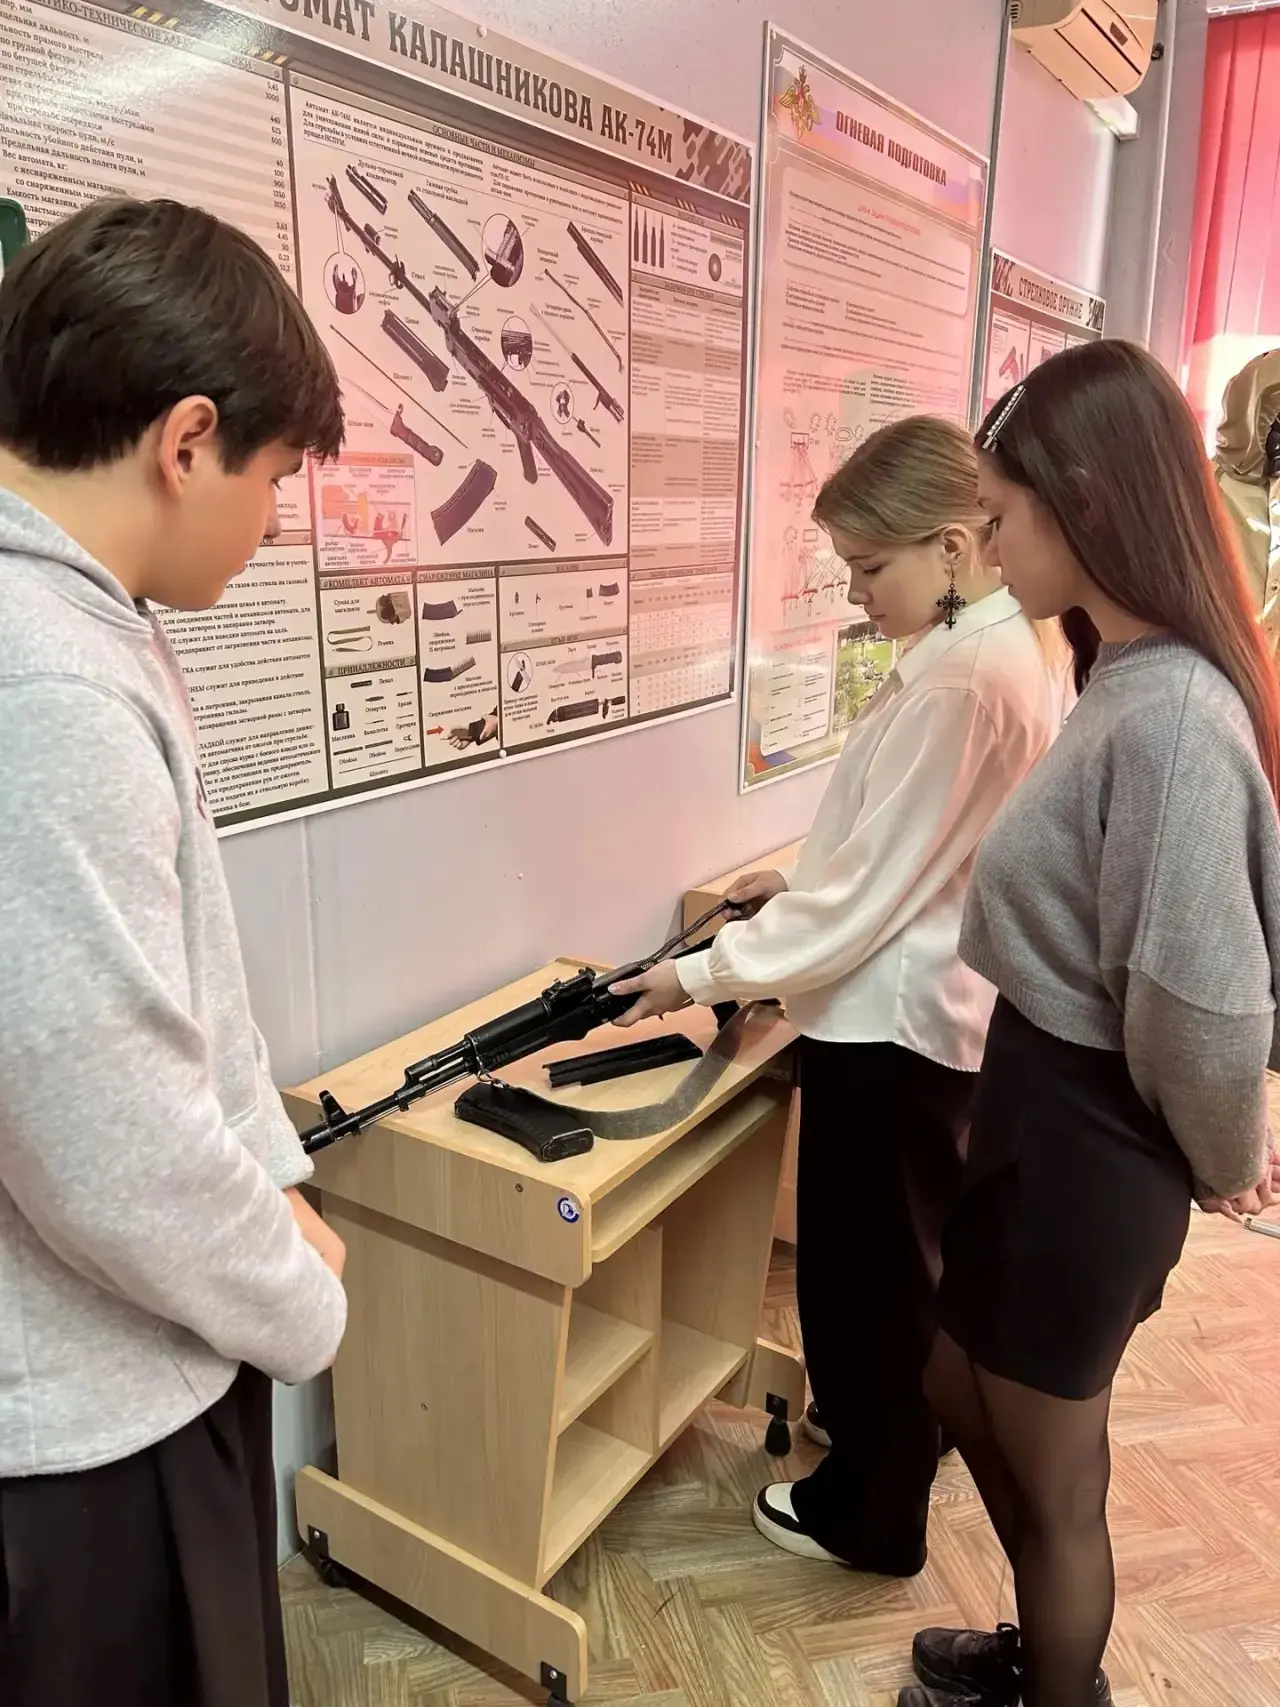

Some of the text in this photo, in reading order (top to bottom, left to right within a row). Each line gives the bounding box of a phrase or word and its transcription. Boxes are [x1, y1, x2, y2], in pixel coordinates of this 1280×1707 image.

[12, 40, 46, 56] грудной
[33, 34, 67, 49] прямого
[13, 50, 47, 68] бегущей
[388, 11, 593, 131] КАЛАШНИКОВА
[600, 104, 673, 163] АК-74М
[265, 92, 279, 102] 1000
[305, 101, 329, 114] Автомат
[270, 115, 280, 124] 440
[303, 118, 314, 127] Для
[315, 123, 340, 136] стрельбы
[0, 123, 136, 163] Дальность убойного действия пули,
[43, 123, 77, 137] скорость
[100, 136, 115, 147] м/с
[432, 125, 536, 167] ОСНОВНЫЕ ЧАСТИ МЕХАНИЗМЫ
[836, 110, 947, 187] ОГНЕВАЯ ПОДГОТОВКА
[0, 135, 139, 177] Предельная дальность полета пули,
[2, 149, 55, 169] Вес автомата,
[20, 165, 85, 186] неснаряженным
[274, 169, 284, 177] 100
[15, 177, 24, 186] со
[26, 179, 81, 197] снаряженным
[273, 180, 284, 189] 900
[6, 187, 40, 201] Емкость
[1019, 277, 1083, 320] СТРЕЛКОВОЕ ОРУЖИЕ
[259, 580, 277, 588] ствола
[285, 577, 308, 585] газовый
[328, 574, 406, 589] КОМПЛЕКТ АВТОМАТА
[418, 568, 494, 583] СНАРЯЖЕНИЕ МАГАЗИНА
[239, 601, 256, 609] цевья
[349, 598, 360, 606] для
[176, 615, 213, 625] соединения
[214, 612, 234, 621] частей
[239, 609, 273, 618] механизмов
[300, 606, 311, 614] для
[166, 620, 253, 635] ствола затвором запирания
[178, 635, 201, 646] служит
[203, 634, 214, 642] для
[215, 632, 239, 641] наводки
[240, 630, 266, 639] автомата
[224, 640, 260, 651] загрязнения
[260, 638, 276, 647] части
[195, 653, 311, 674] служит для удобства действия автоматом
[337, 658, 406, 675] ПРИНАДЛЕЖНОСТИ
[205, 682, 228, 693] служит
[241, 676, 275, 688] приведения
[280, 672, 304, 681] действие
[239, 695, 273, 706] закрывания
[273, 692, 292, 700] канала
[365, 705, 387, 713] Отвертка
[198, 706, 312, 731] возвращения затворной рамы затвором
[395, 721, 417, 730] Протирка
[225, 728, 295, 747] служит для направления
[332, 733, 356, 742] Масленка
[363, 726, 389, 736] Выколотка
[207, 746, 244, 759] автоматчика
[252, 740, 273, 750] ожогов
[273, 738, 284, 746] при
[207, 760, 219, 768] для
[219, 757, 239, 767] спуска
[239, 753, 255, 763] курка
[259, 748, 280, 758] боевого
[280, 744, 298, 754] взвода
[298, 742, 309, 750] или
[368, 750, 387, 759] Обойма
[222, 748, 321, 773] обеспечения ведения автоматического
[220, 775, 231, 783] для
[231, 769, 263, 781] постановки
[206, 787, 218, 796] для
[218, 779, 262, 793] предохранения
[262, 777, 273, 785] рук
[225, 782, 288, 802] подачи ствольную
